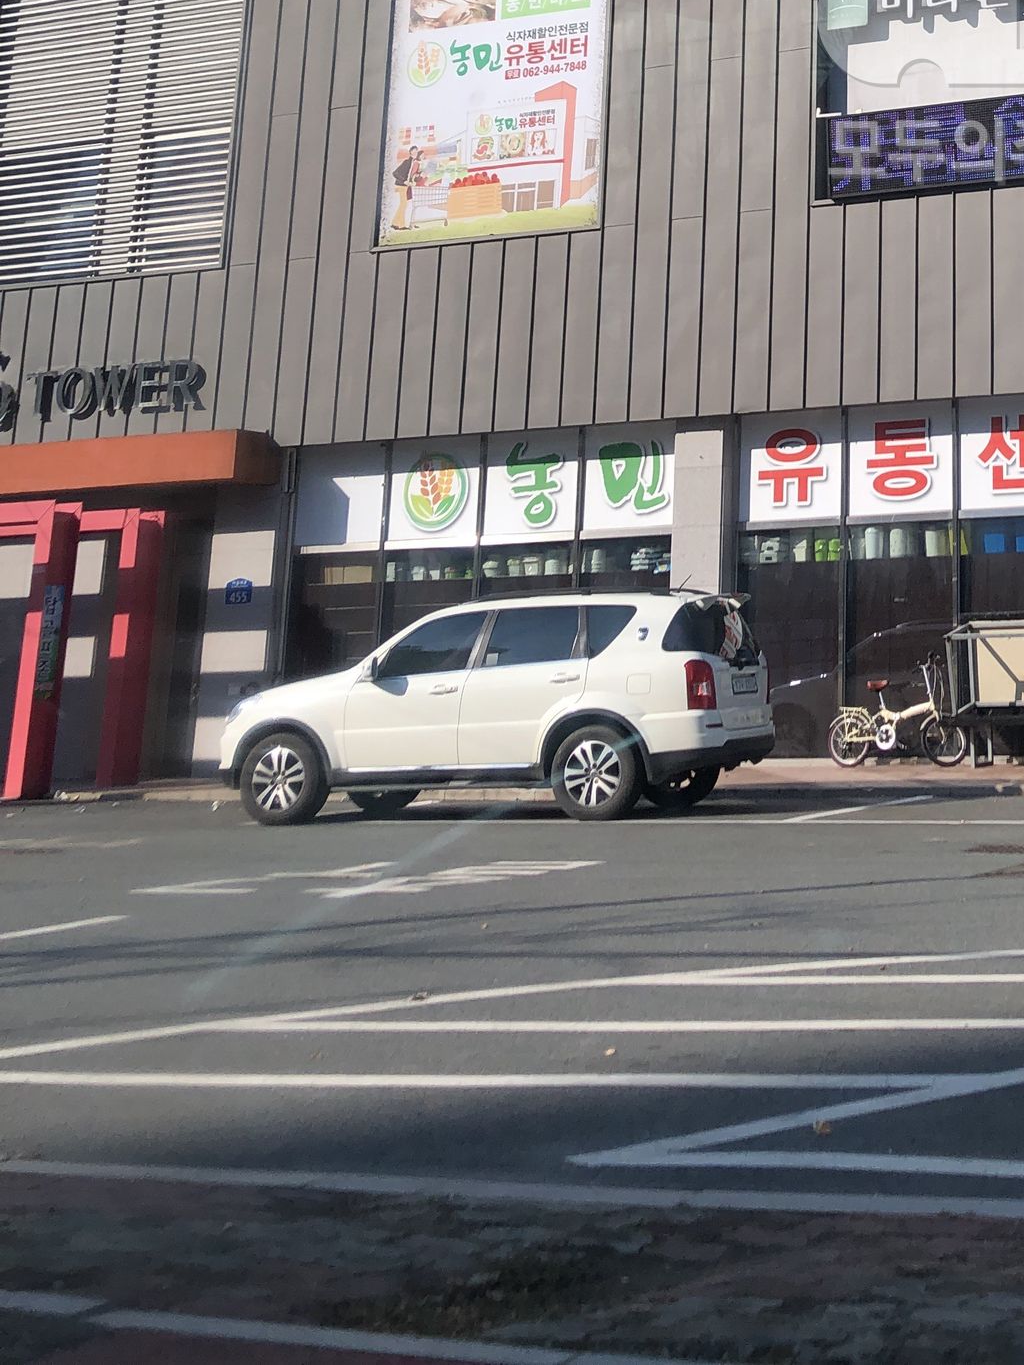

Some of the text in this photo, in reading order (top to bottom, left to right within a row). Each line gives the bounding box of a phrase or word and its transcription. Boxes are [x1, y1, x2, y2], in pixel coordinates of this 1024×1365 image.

[506, 21, 589, 43] 식자재할인전문점
[450, 35, 589, 76] 농민 유통센터
[522, 60, 587, 78] 062-944-7848
[27, 359, 201, 418] TOWER
[506, 439, 669, 526] 농민
